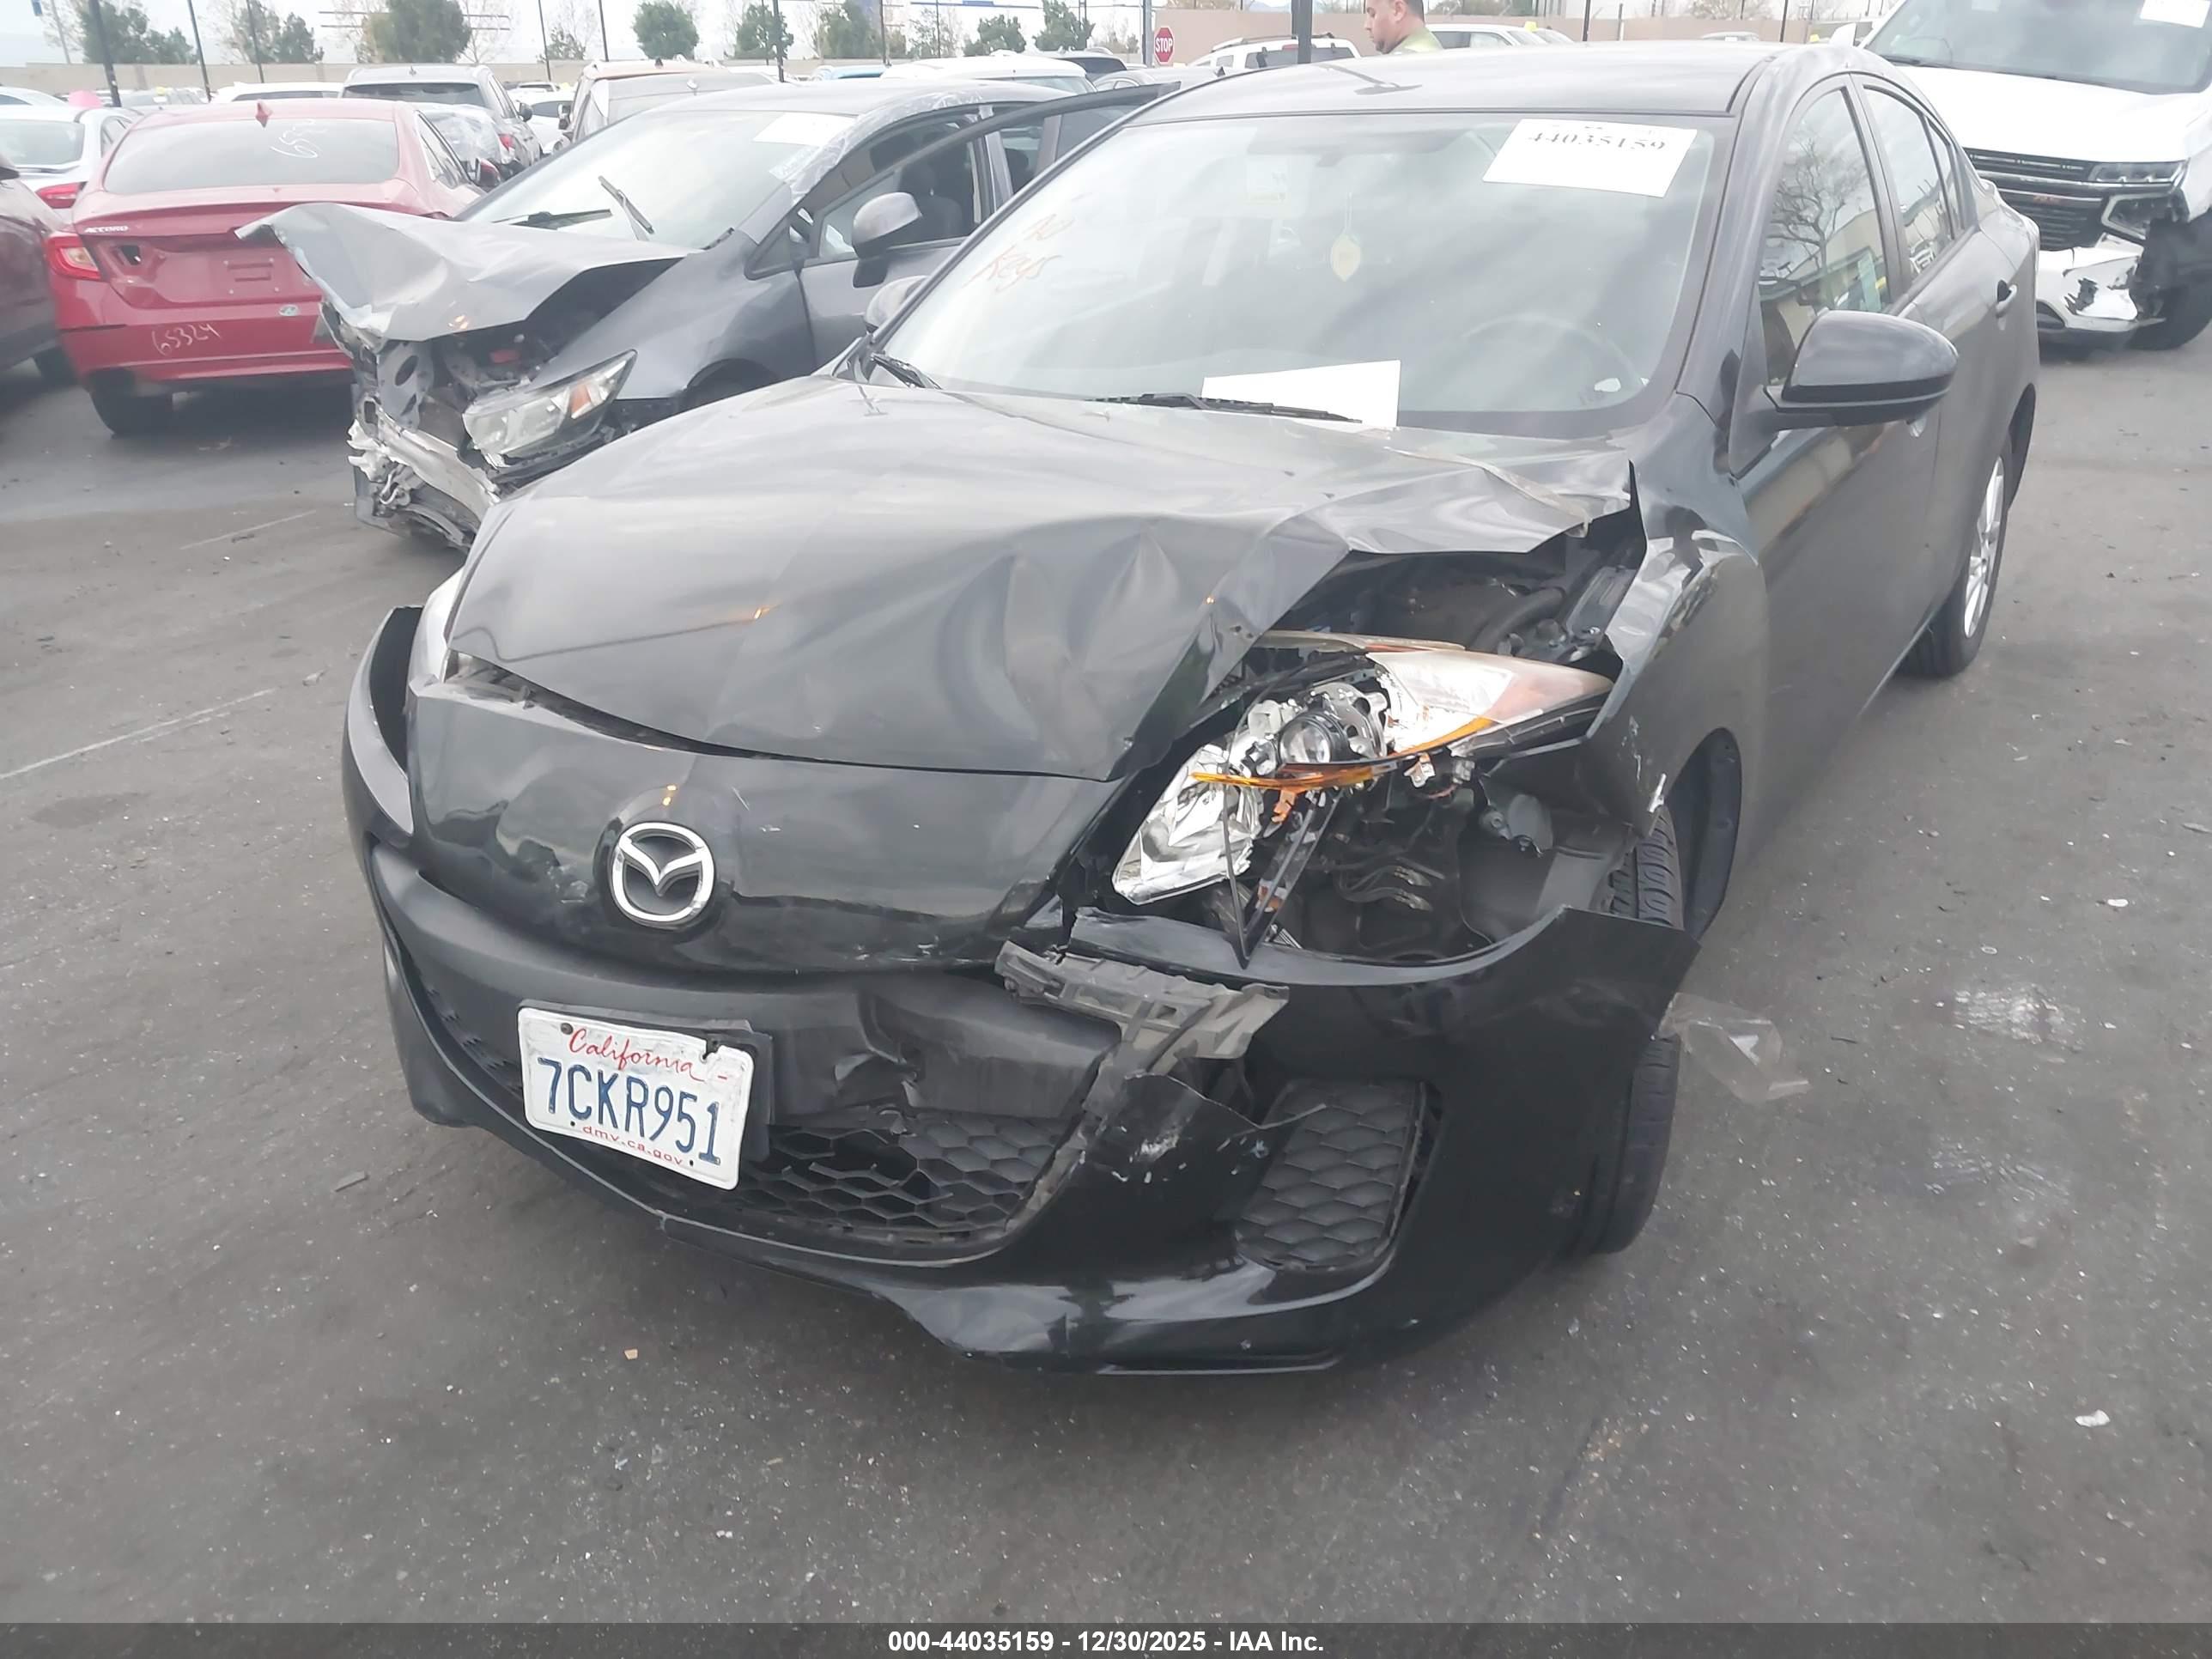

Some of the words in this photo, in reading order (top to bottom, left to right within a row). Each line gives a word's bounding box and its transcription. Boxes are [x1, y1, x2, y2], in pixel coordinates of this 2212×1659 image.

[1155, 37, 1173, 52] STOP
[84, 225, 129, 234] ACCORD
[151, 323, 221, 356] 65324
[568, 1027, 706, 1083] California
[537, 1057, 721, 1166] 7CKR951
[581, 1125, 684, 1167] dmv.ca.gov
